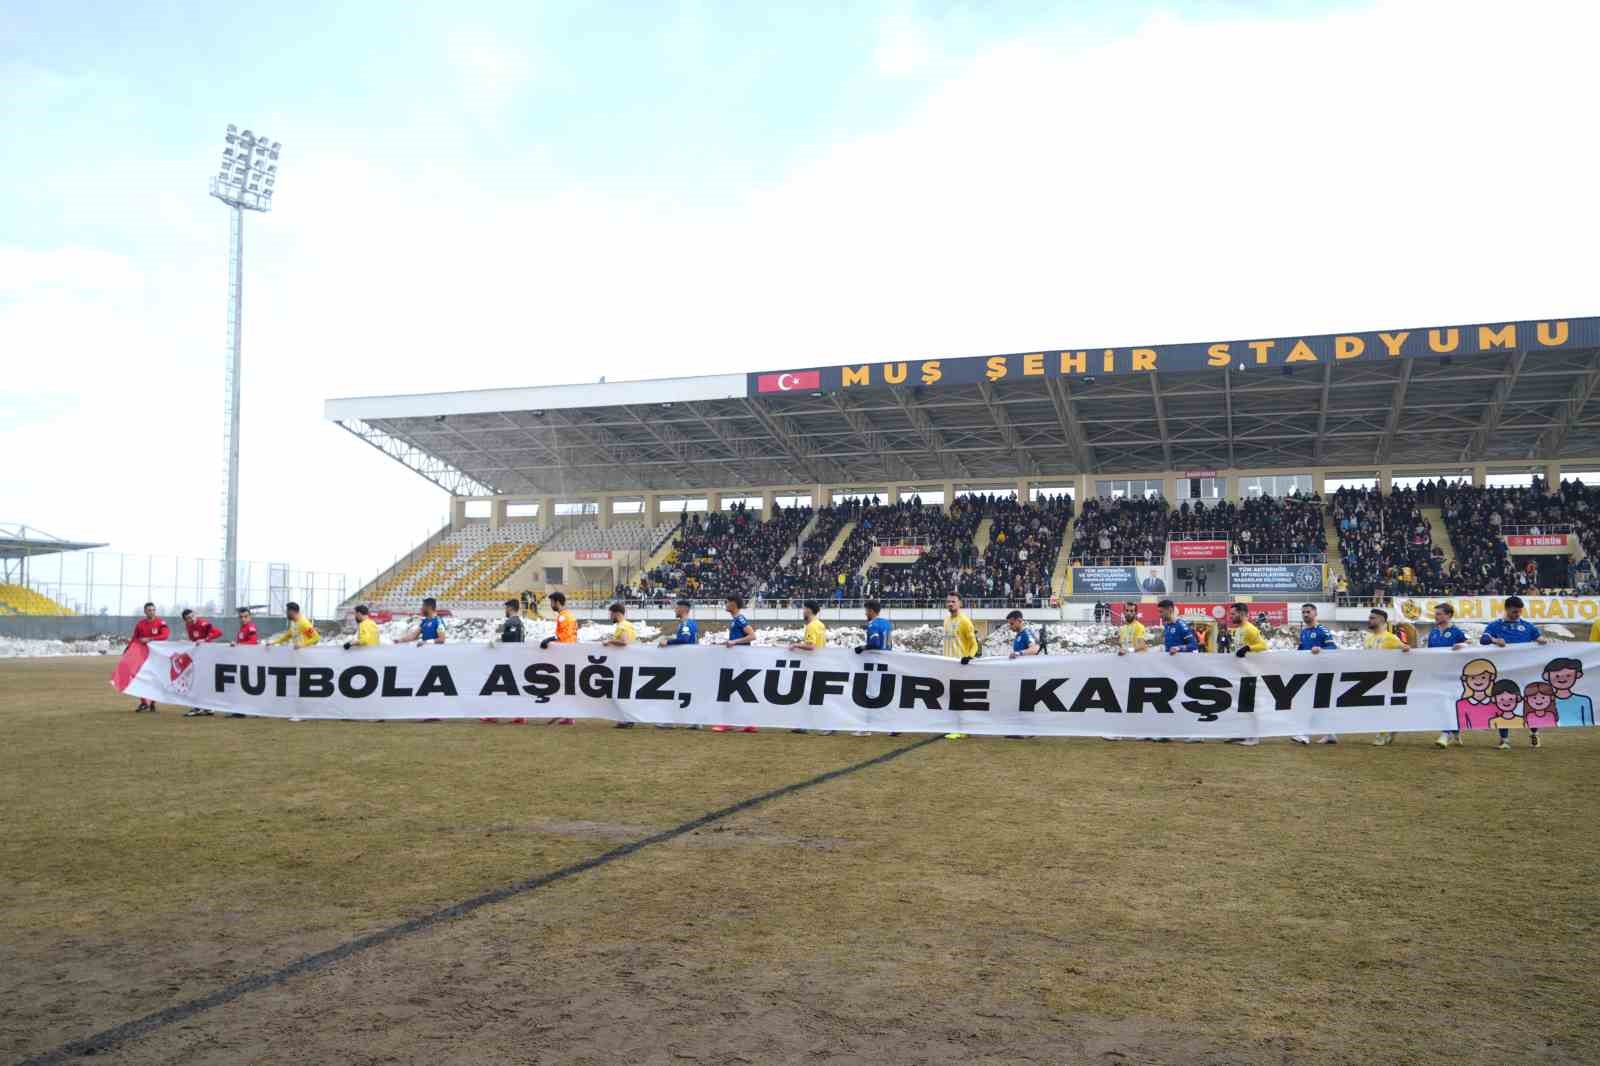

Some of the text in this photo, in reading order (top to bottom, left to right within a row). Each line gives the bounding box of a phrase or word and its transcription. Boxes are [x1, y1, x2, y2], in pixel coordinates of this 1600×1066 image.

[842, 320, 1569, 386] MUŞ ŞEHİR STADYUMU
[215, 655, 1414, 722] FUTBOLA AŞIĞIZ, KÜFÜRE KARŞIYIZ!
